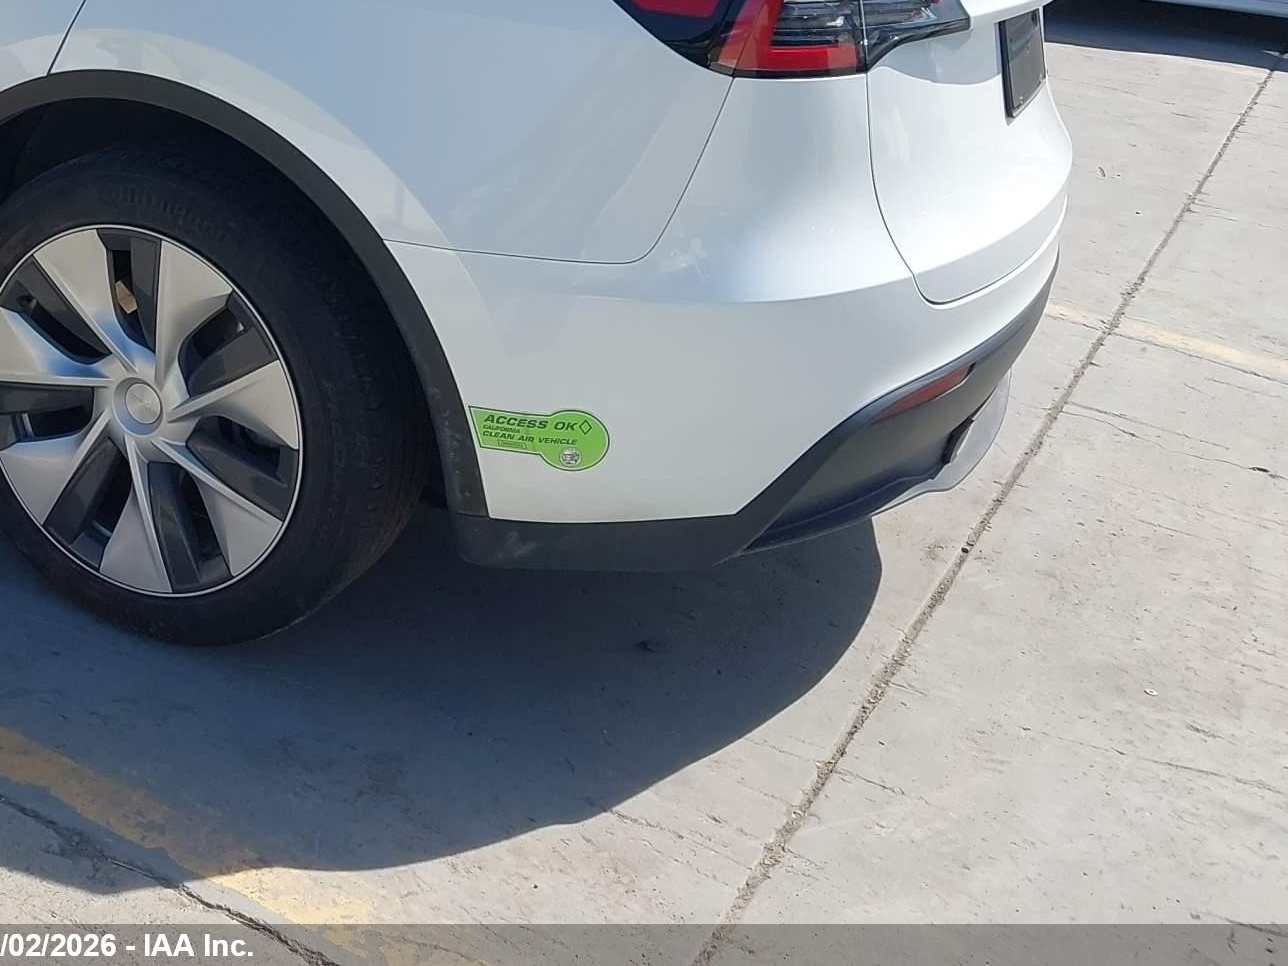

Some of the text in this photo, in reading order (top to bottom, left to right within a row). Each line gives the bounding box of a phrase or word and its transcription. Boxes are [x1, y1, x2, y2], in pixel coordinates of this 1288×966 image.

[482, 424, 521, 434] CALIFORNIA
[483, 415, 578, 431] ACCESS OK
[482, 430, 577, 445] CLEAN AIR VEHICLE
